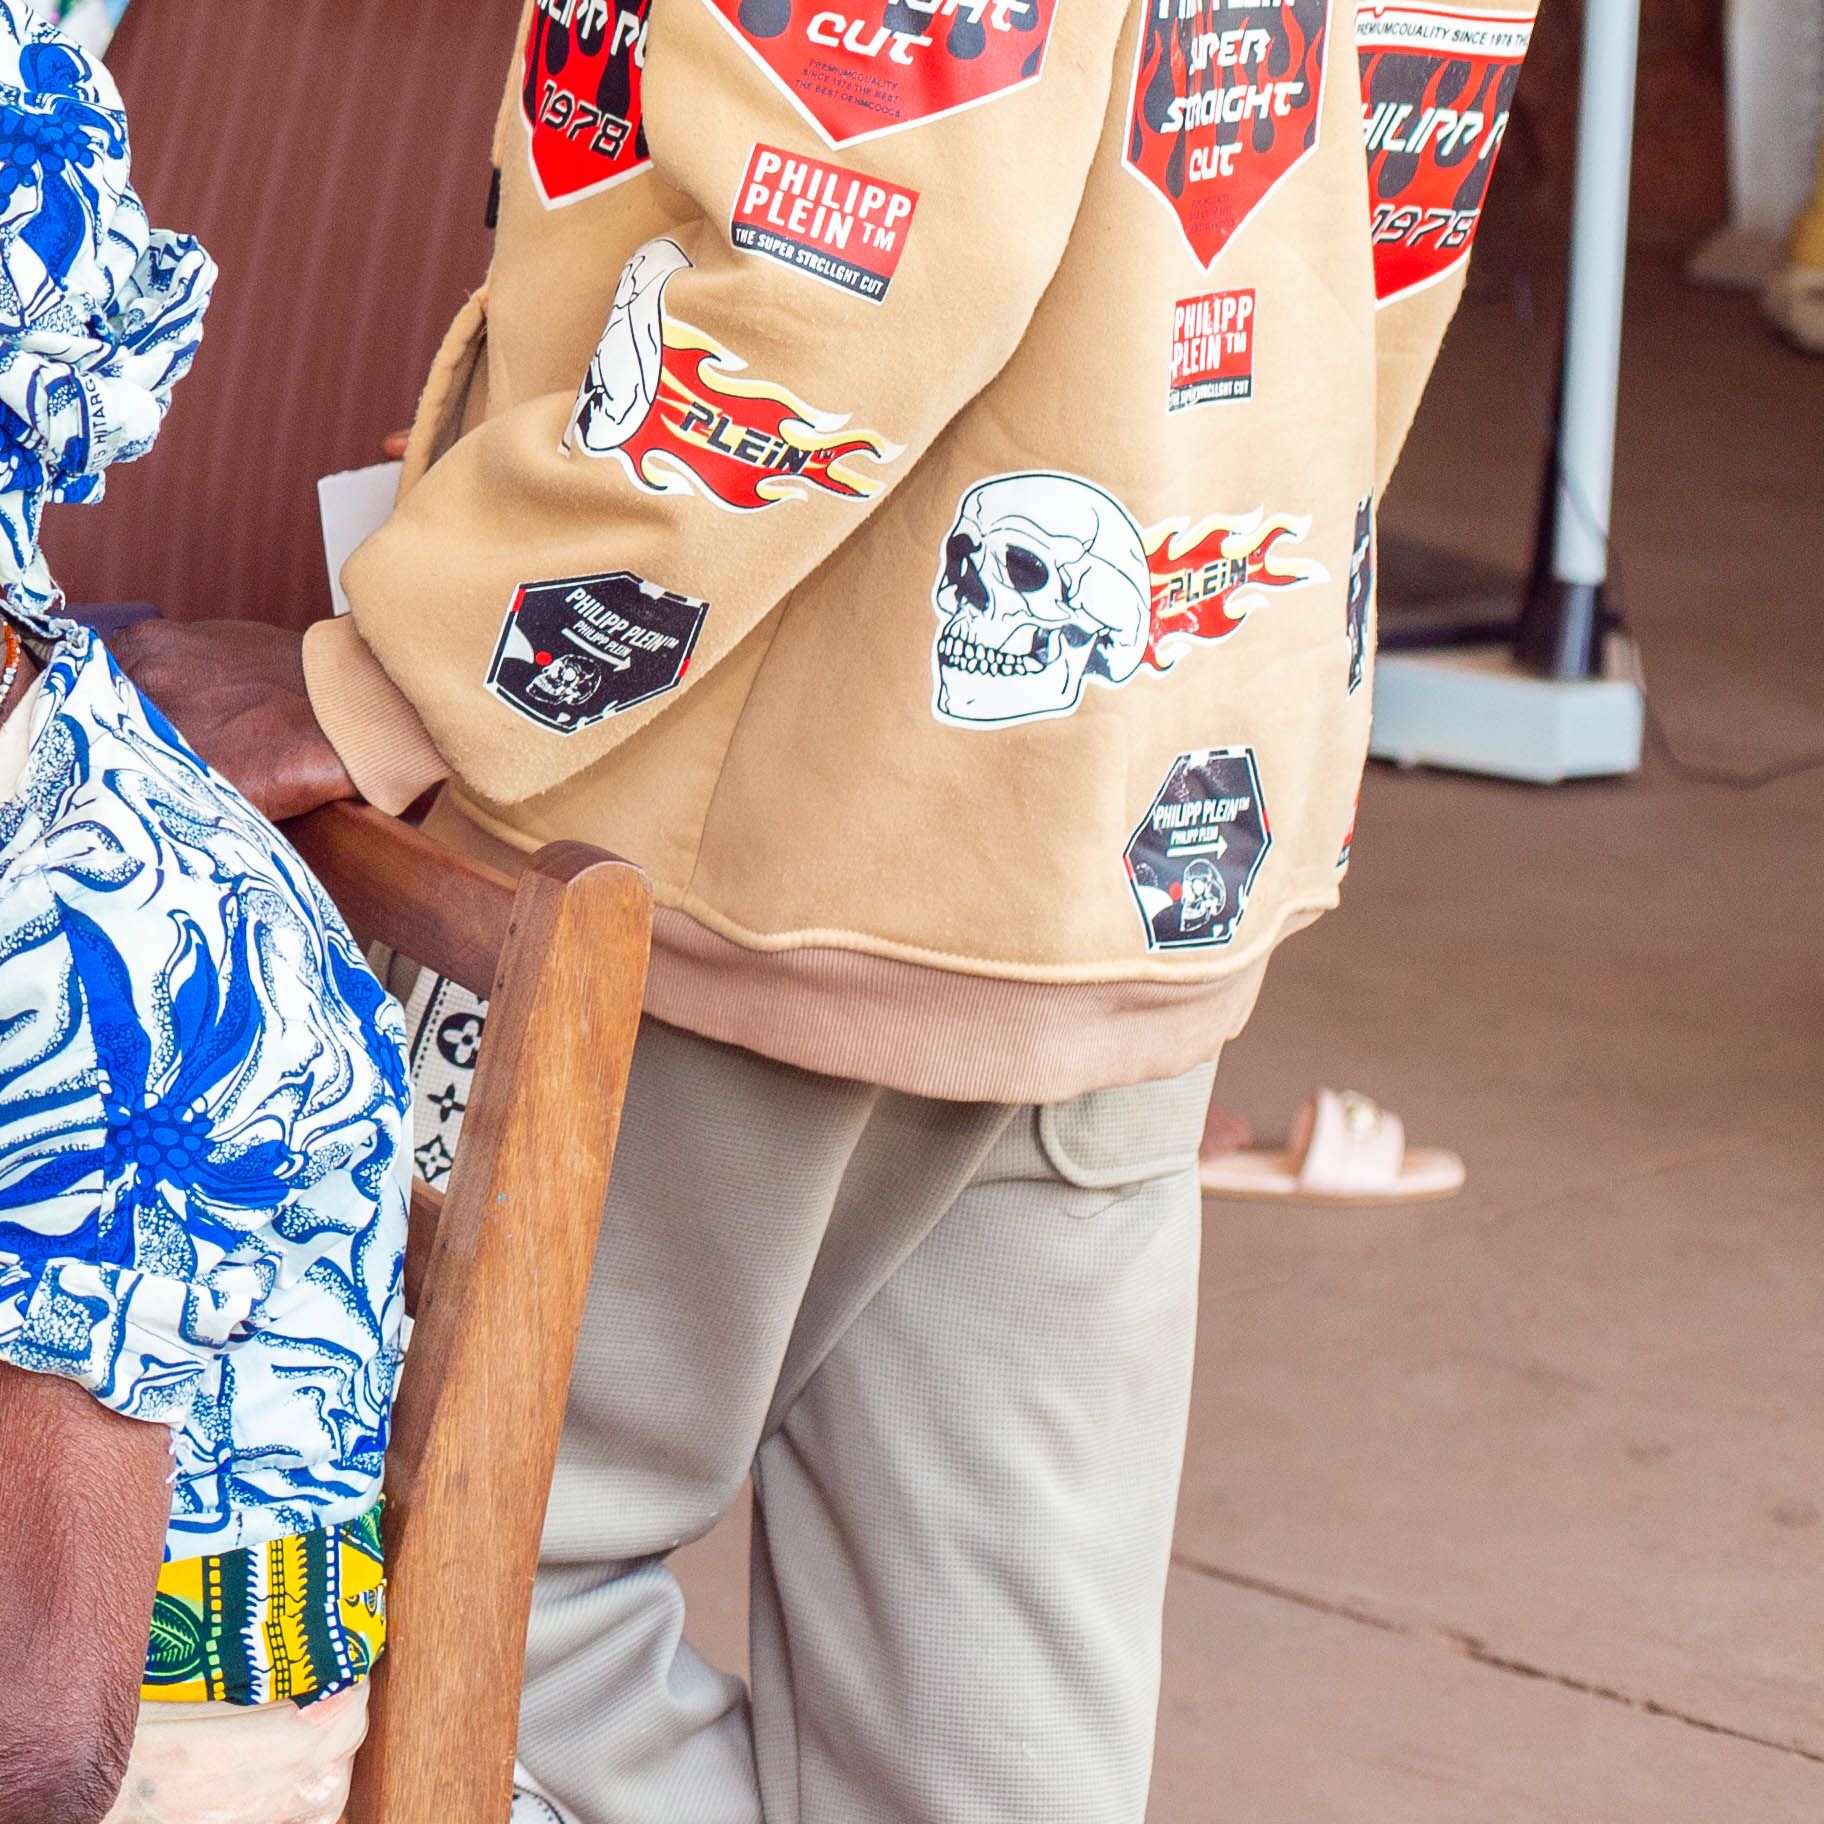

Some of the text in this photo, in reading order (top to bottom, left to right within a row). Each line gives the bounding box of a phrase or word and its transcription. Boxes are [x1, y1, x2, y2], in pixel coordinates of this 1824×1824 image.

[806, 11, 933, 65] CUT
[1452, 29, 1488, 46] SINCE
[538, 78, 632, 161] 1978
[1187, 142, 1243, 183] CUT
[753, 151, 912, 228] PHILIPP
[743, 183, 854, 249] PLEIN
[736, 228, 755, 245] THE
[757, 234, 793, 259] SUPER
[859, 277, 885, 295] CUT
[1174, 296, 1253, 341] PHILIPP
[1171, 334, 1222, 380] PLEIN
[565, 587, 629, 635] PHILIPP
[572, 620, 633, 657] PHILIPP PLEIN
[1153, 801, 1203, 830] PHILIPP
